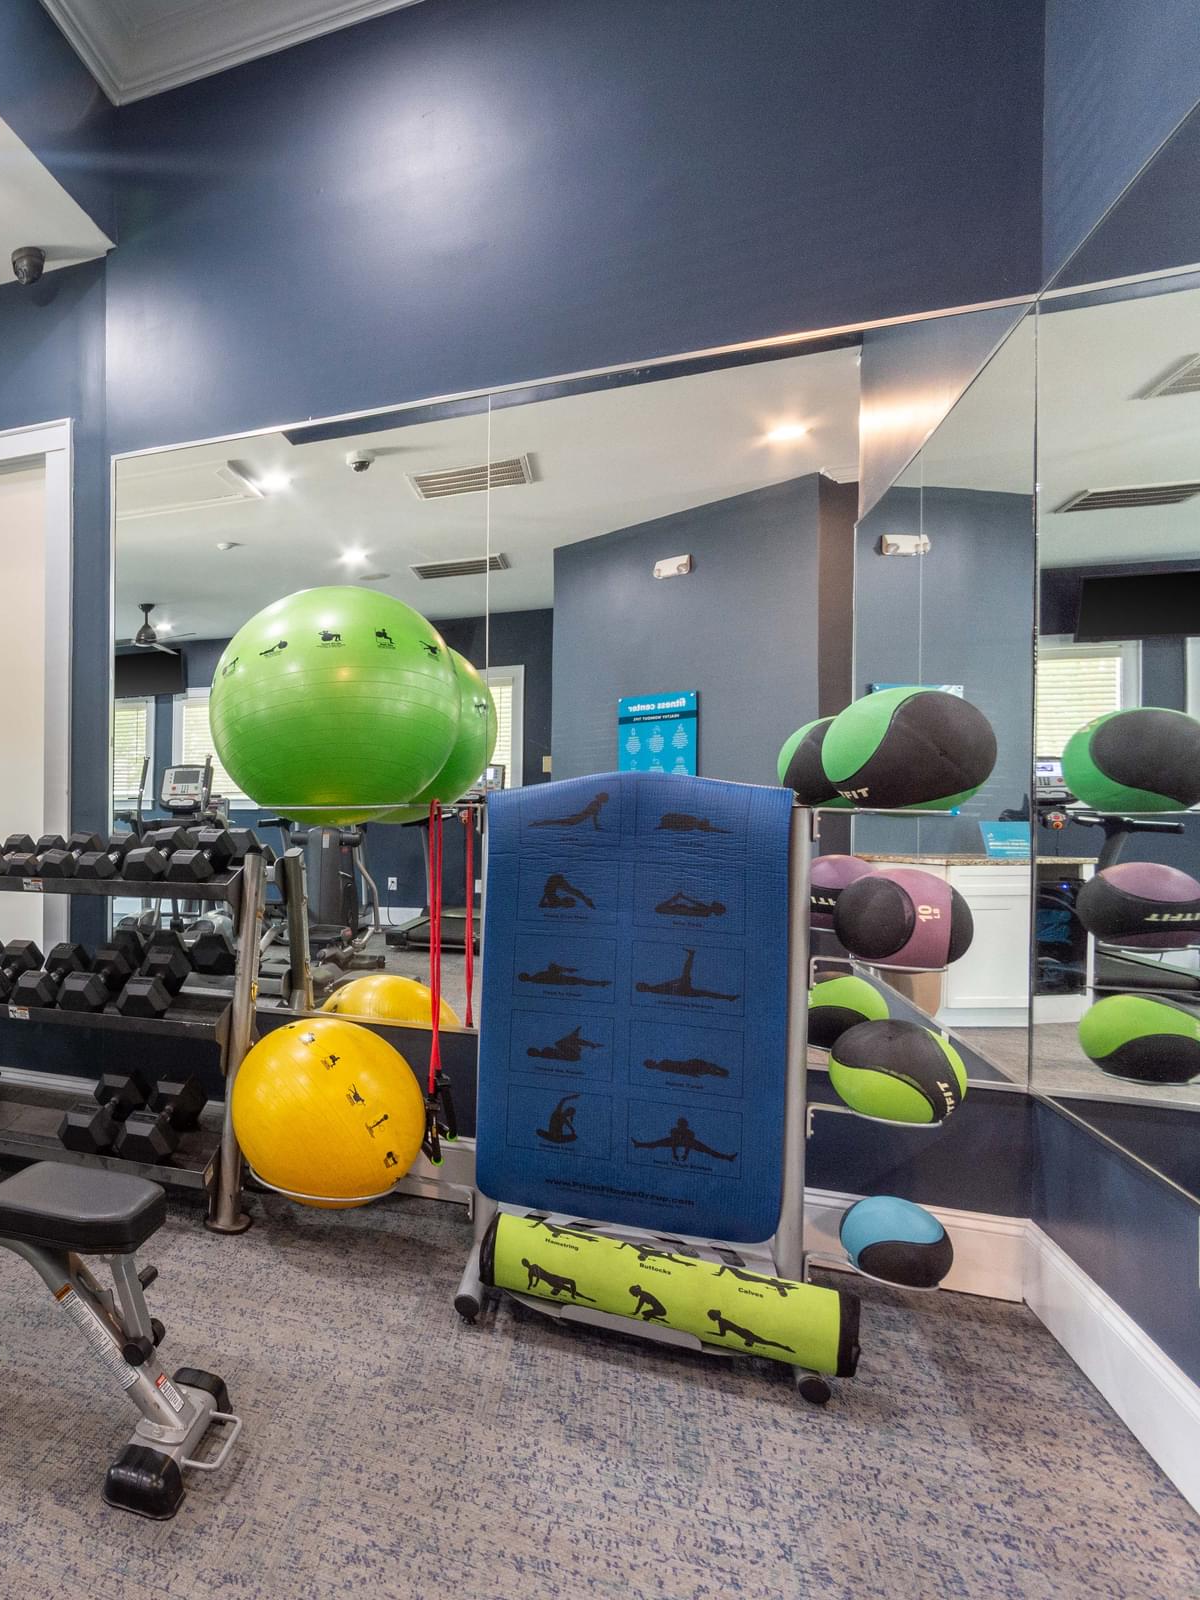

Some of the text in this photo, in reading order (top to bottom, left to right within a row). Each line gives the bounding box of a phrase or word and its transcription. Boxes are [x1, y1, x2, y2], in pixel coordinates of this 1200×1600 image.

[918, 904, 933, 923] 10
[544, 1237, 580, 1251] Hamstring
[639, 1262, 672, 1276] Buttocks
[737, 1286, 764, 1298] Calves
